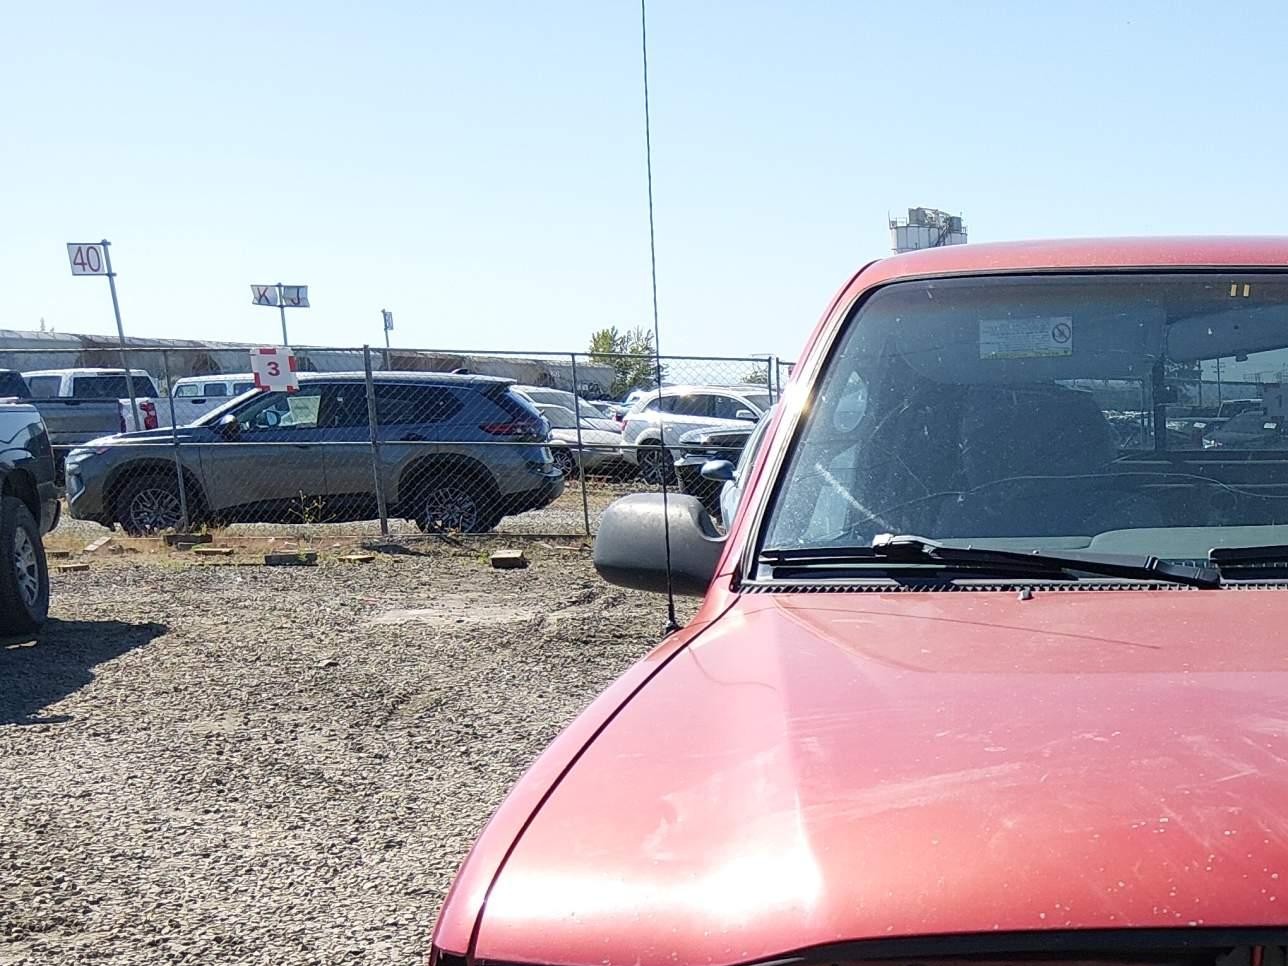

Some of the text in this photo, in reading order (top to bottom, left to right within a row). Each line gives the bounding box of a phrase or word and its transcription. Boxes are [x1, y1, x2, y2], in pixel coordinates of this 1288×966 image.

[73, 246, 101, 272] 40
[257, 287, 270, 305] K
[290, 287, 300, 305] J
[267, 361, 280, 377] 3
